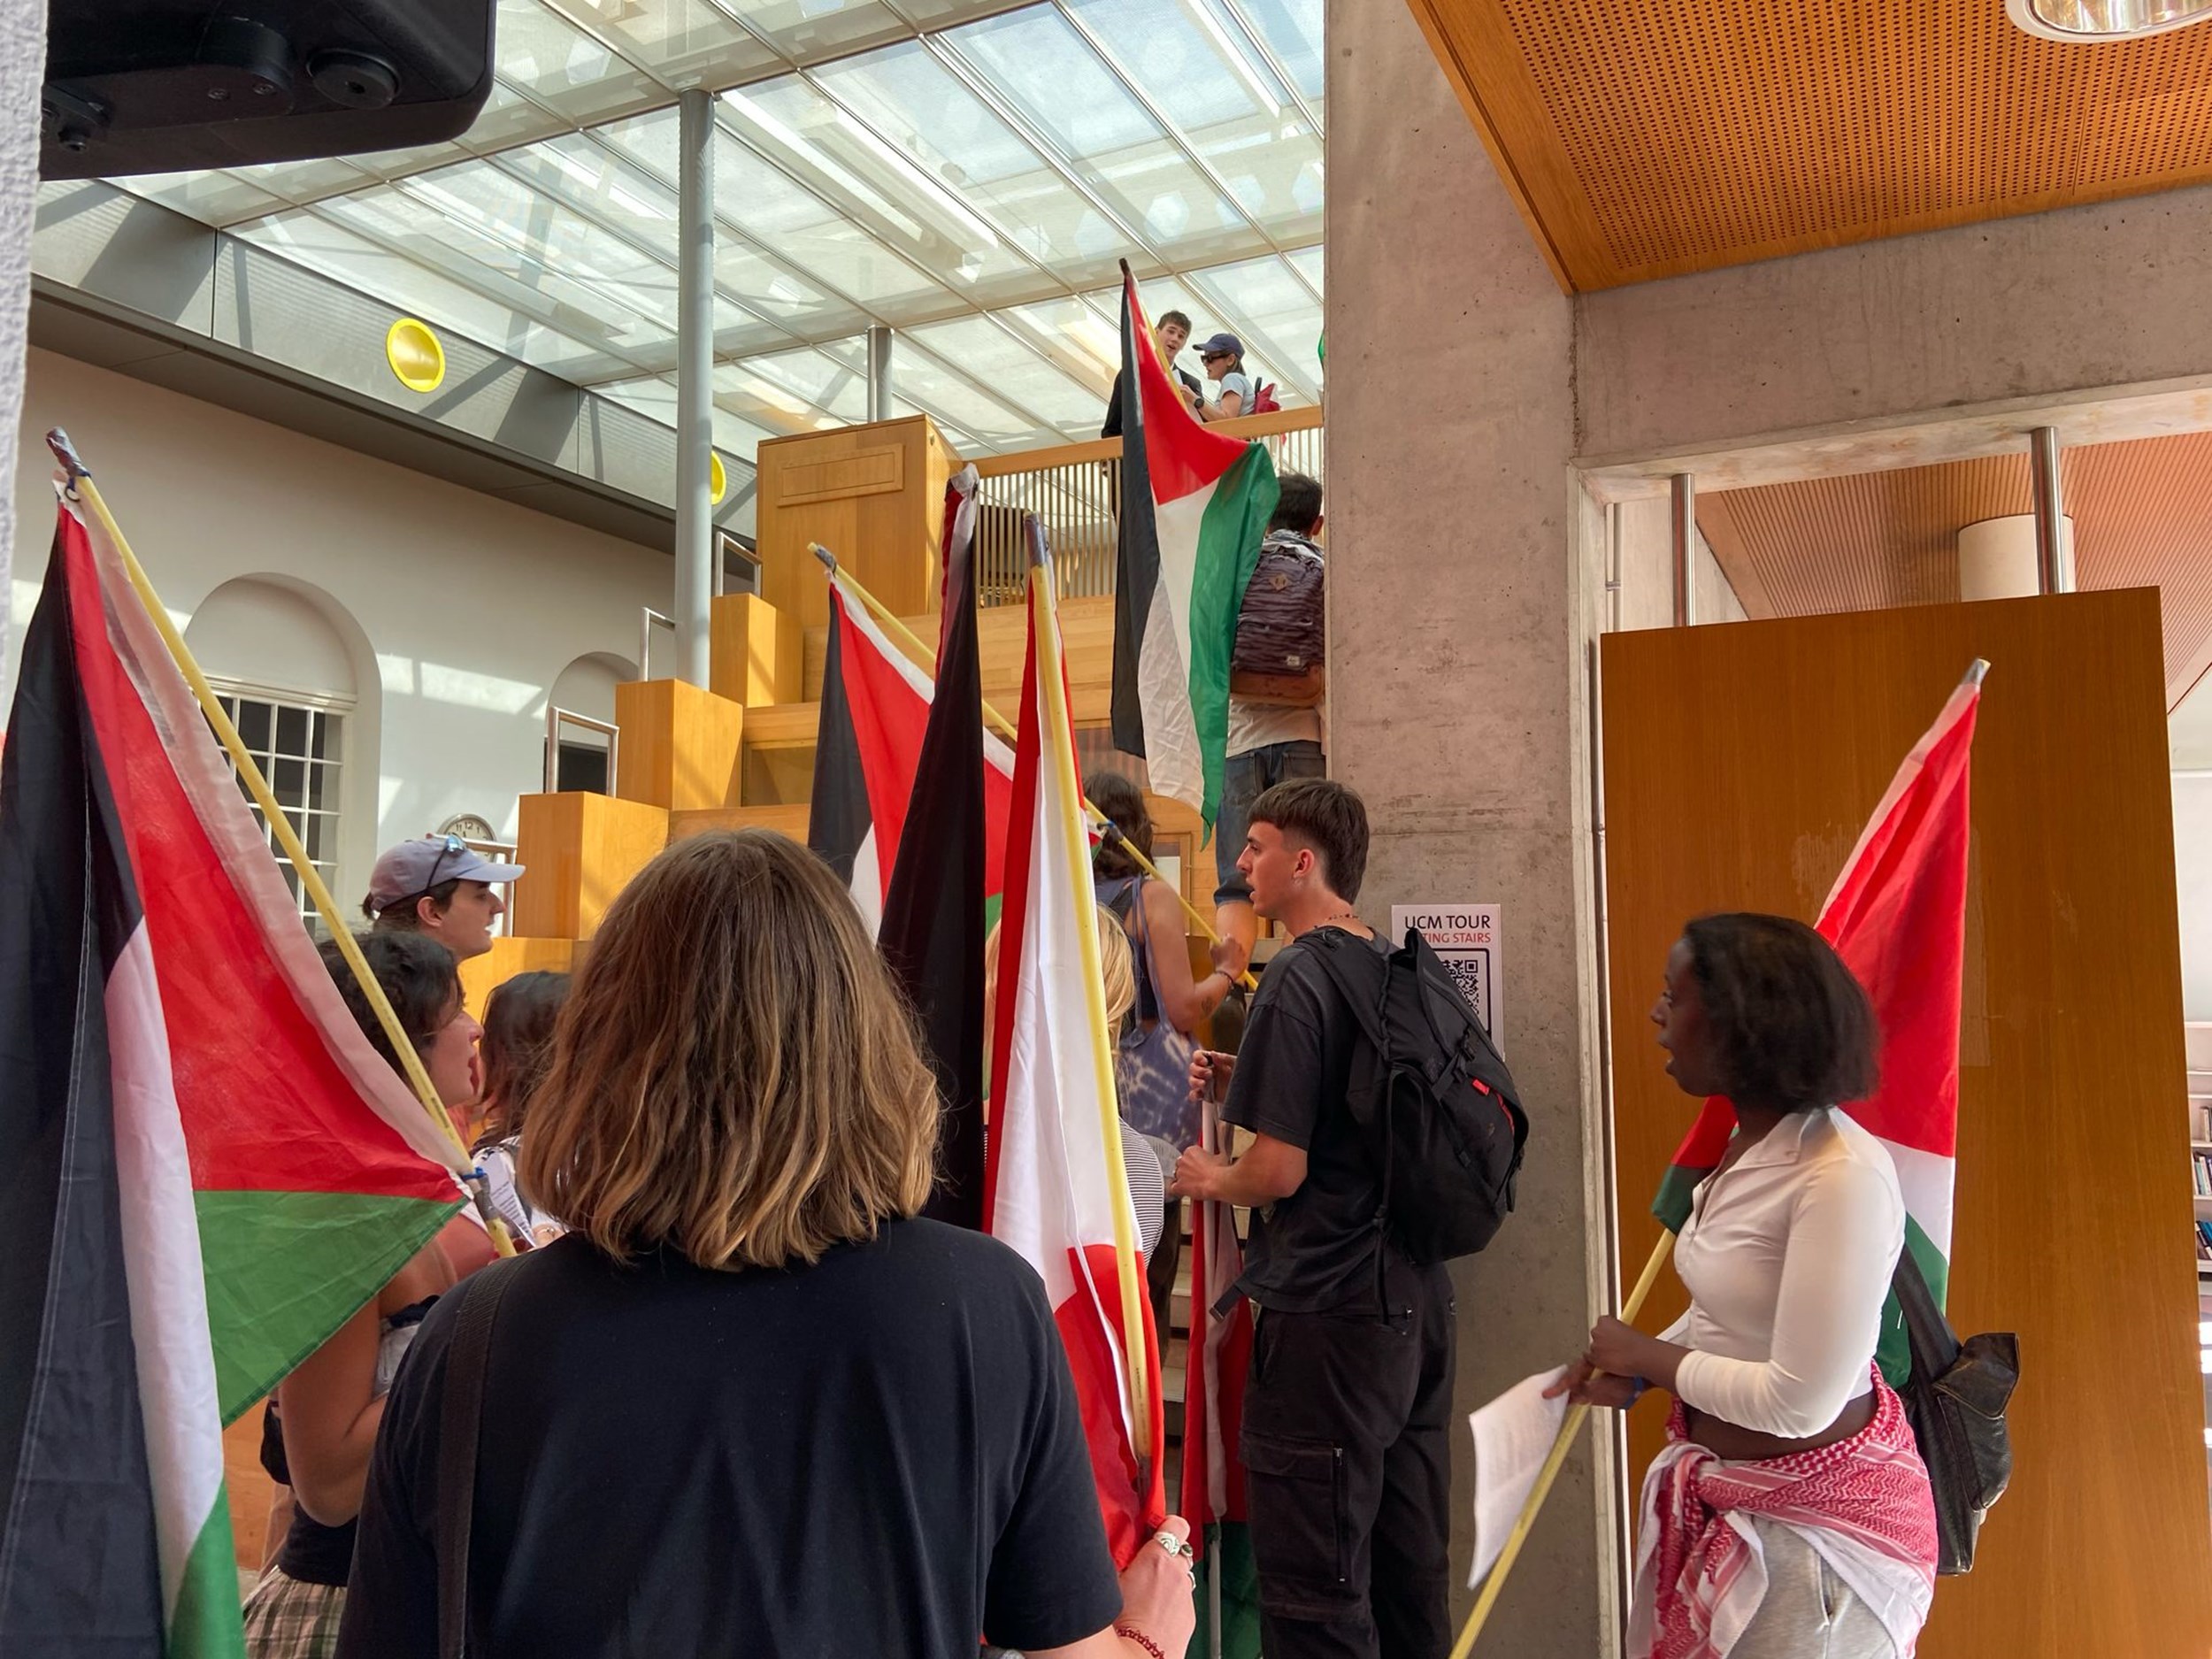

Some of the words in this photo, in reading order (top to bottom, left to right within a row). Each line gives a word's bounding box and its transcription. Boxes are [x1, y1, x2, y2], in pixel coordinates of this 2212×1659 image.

[465, 821, 473, 830] 12
[1404, 915, 1442, 930] UCM
[1446, 915, 1491, 929] TOUR
[1422, 933, 1449, 943] TING
[1453, 933, 1491, 943] STAIRS
